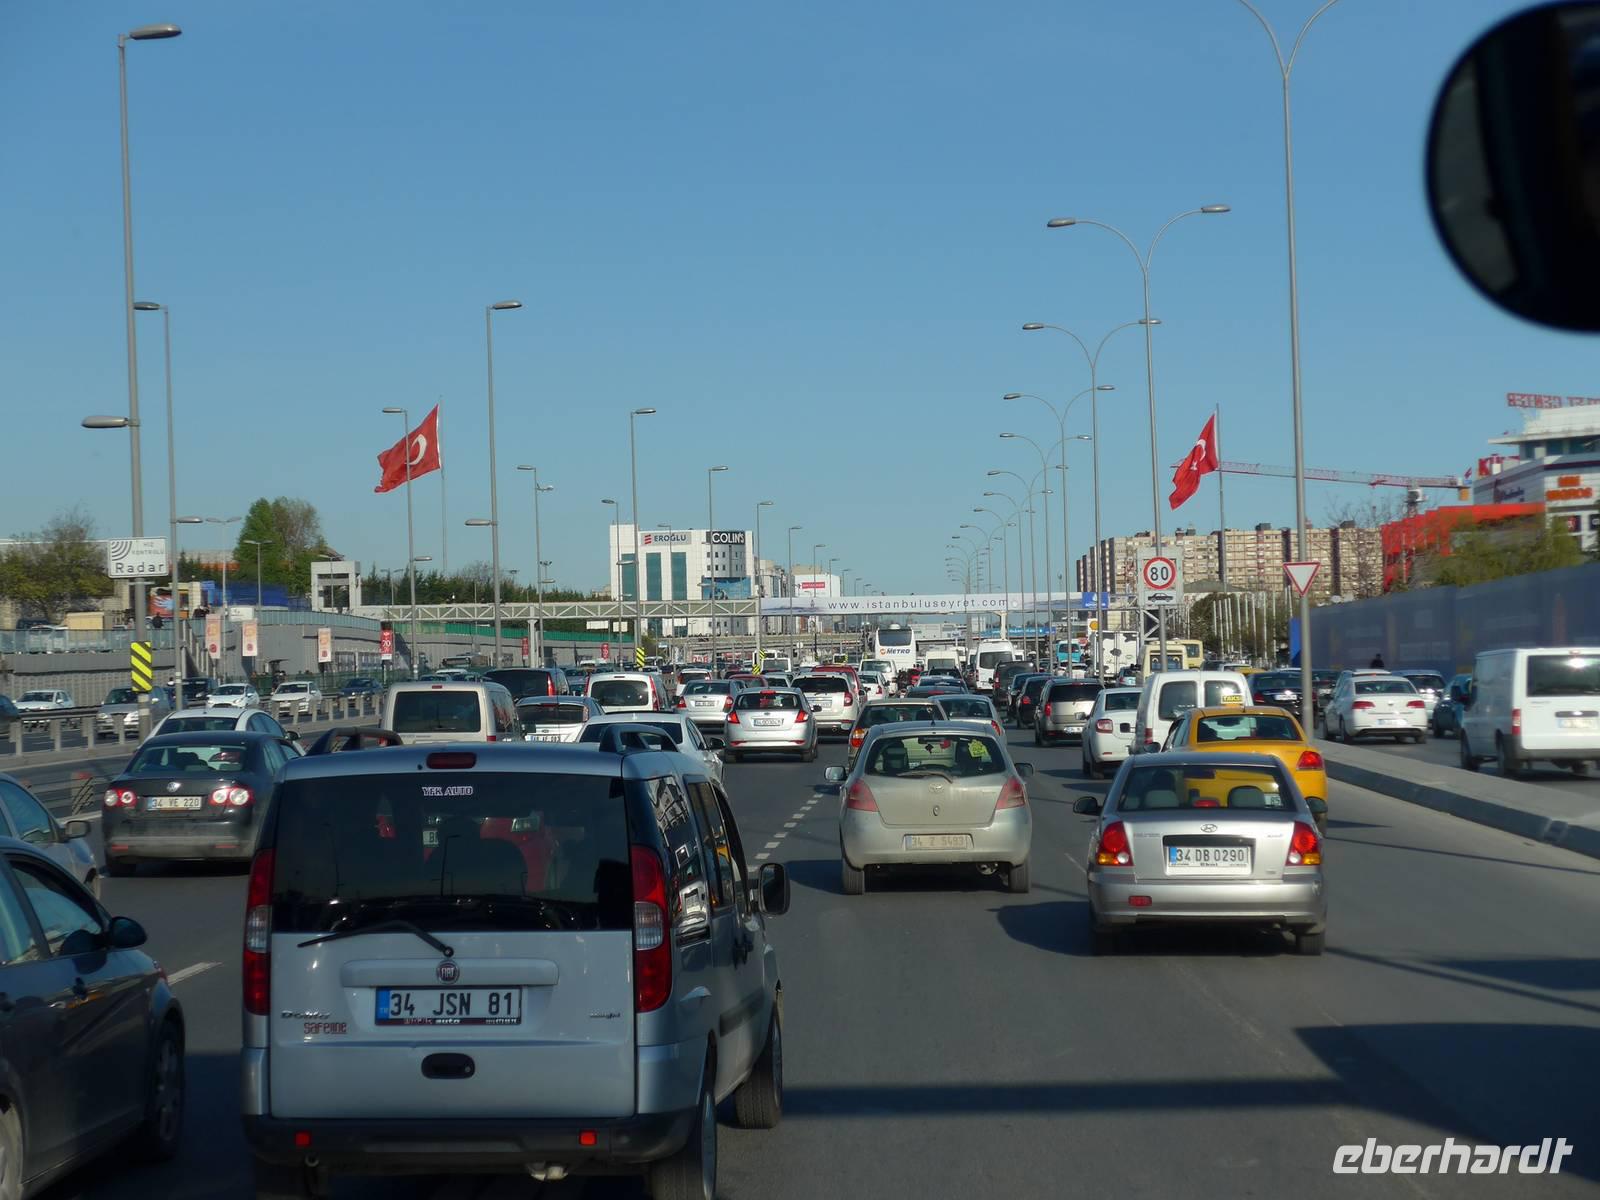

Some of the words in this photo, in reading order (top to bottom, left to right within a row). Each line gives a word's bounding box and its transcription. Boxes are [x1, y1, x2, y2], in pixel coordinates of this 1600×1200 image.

[712, 531, 745, 544] COLIN'S
[115, 561, 165, 574] Radar
[1150, 566, 1169, 581] 80
[828, 598, 1007, 610] www.istanbuluseyret.com
[1176, 849, 1191, 862] 34
[1195, 849, 1210, 862] DB
[1214, 849, 1244, 862] 0290
[441, 967, 456, 978] FIAT
[390, 992, 416, 1016] 34
[433, 992, 471, 1016] JSN
[488, 992, 513, 1016] 81
